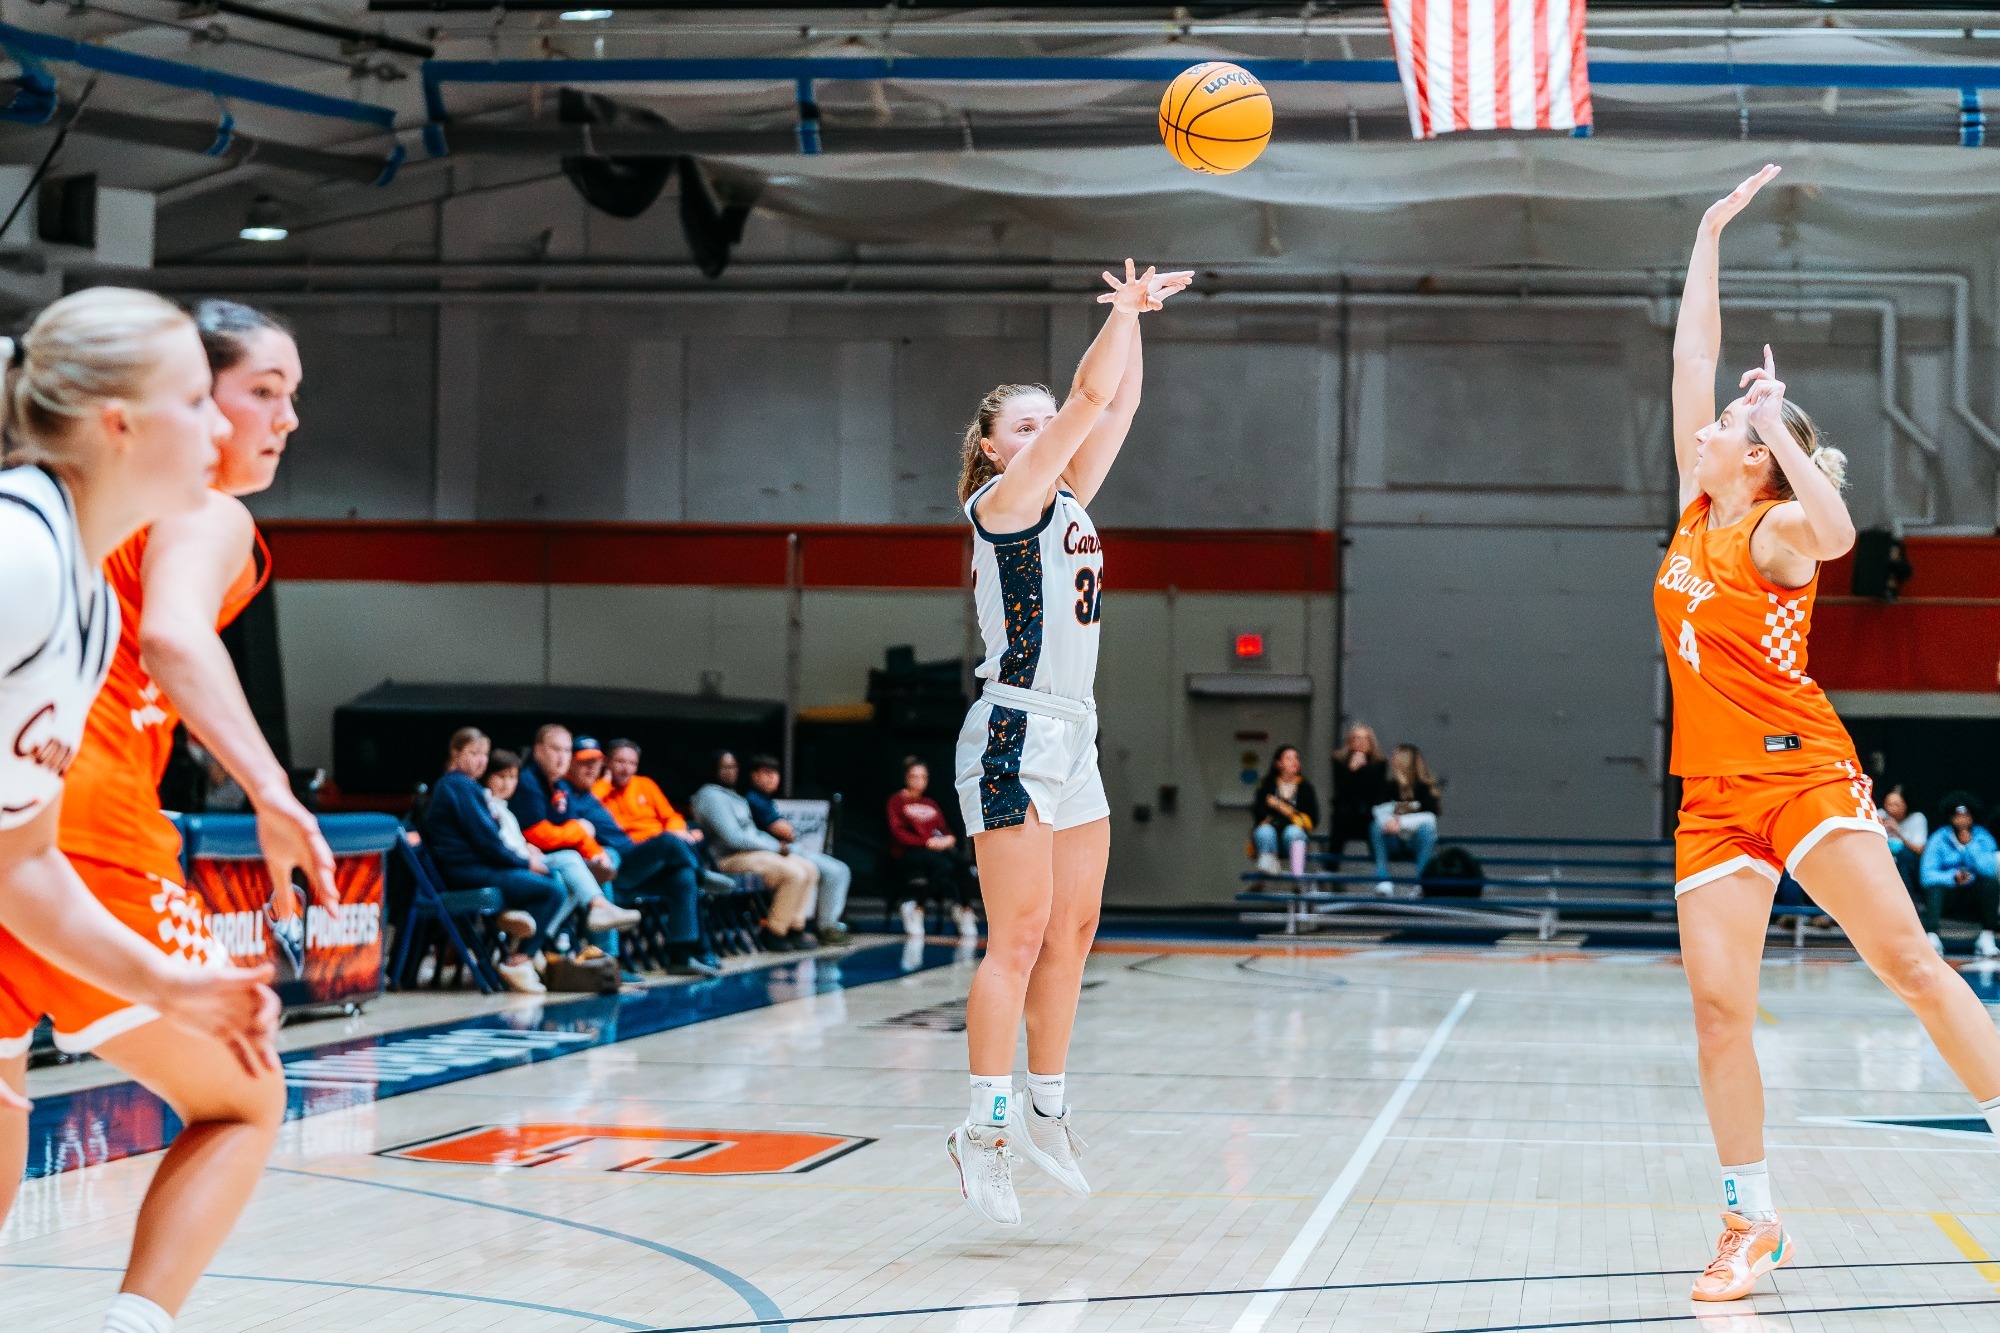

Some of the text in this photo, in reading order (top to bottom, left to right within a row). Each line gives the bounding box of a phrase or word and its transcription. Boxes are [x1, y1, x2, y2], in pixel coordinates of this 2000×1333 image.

[1678, 619, 1700, 674] 4
[203, 902, 380, 956] RROLL PIONEERS
